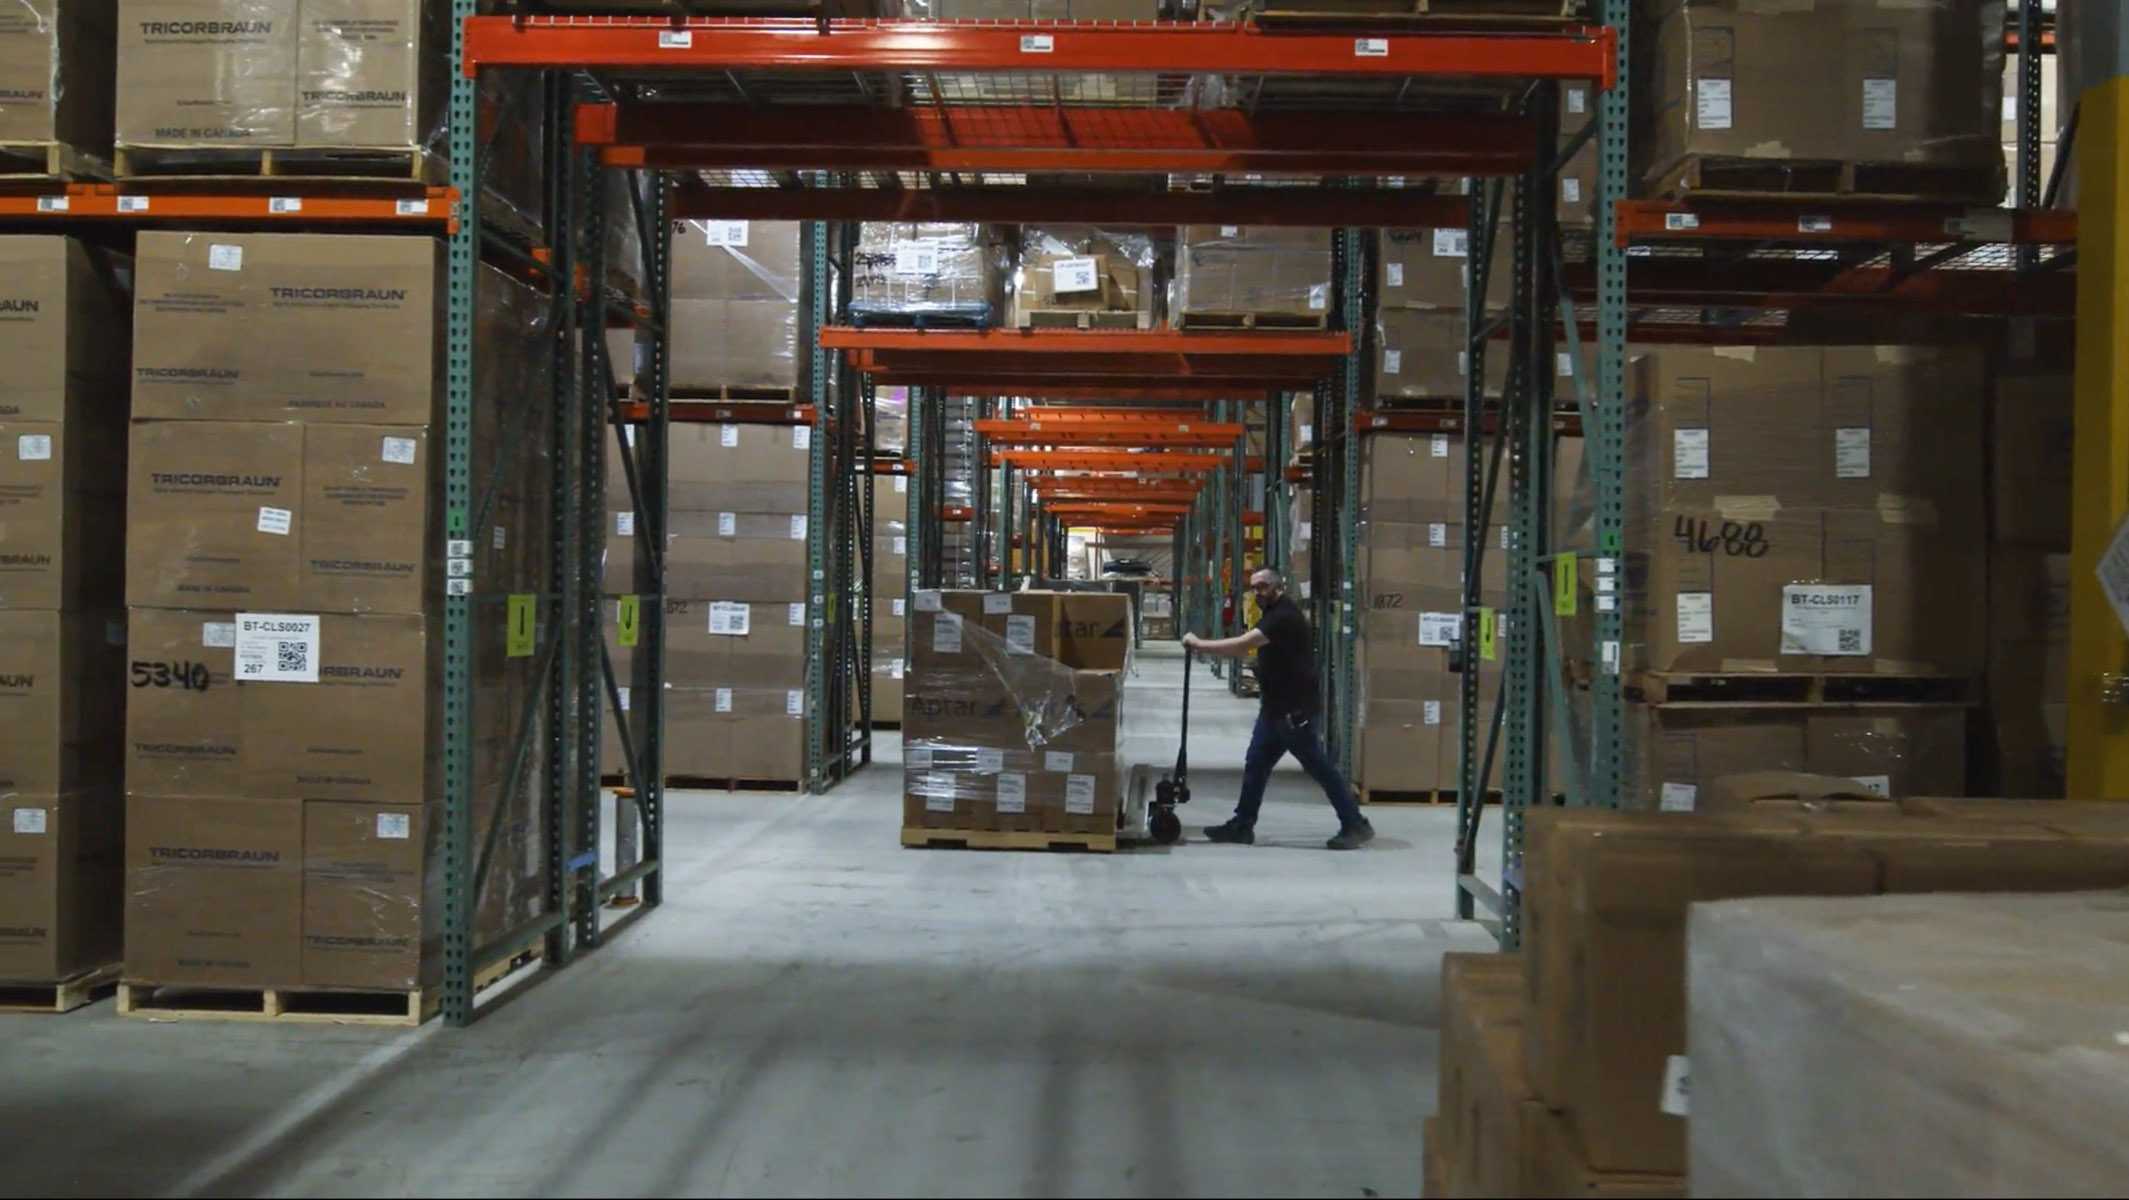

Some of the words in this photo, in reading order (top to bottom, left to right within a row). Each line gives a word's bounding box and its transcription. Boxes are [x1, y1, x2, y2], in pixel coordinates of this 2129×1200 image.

[140, 22, 271, 35] TRICORBRAUN
[302, 91, 406, 102] TRICORBRAUN
[270, 287, 408, 301] TRICORBRAUN
[137, 367, 240, 380] TRICORBRAUN
[151, 473, 283, 489] TRICORBRAUN
[1674, 515, 1769, 558] 4688
[311, 559, 416, 574] TRICORBRAUN
[243, 621, 311, 633] BT-CLS0027
[243, 664, 264, 674] 267
[131, 661, 210, 692] 5340
[135, 743, 237, 756] TRICORBRAUN
[149, 847, 281, 862] TRICORBRAUN
